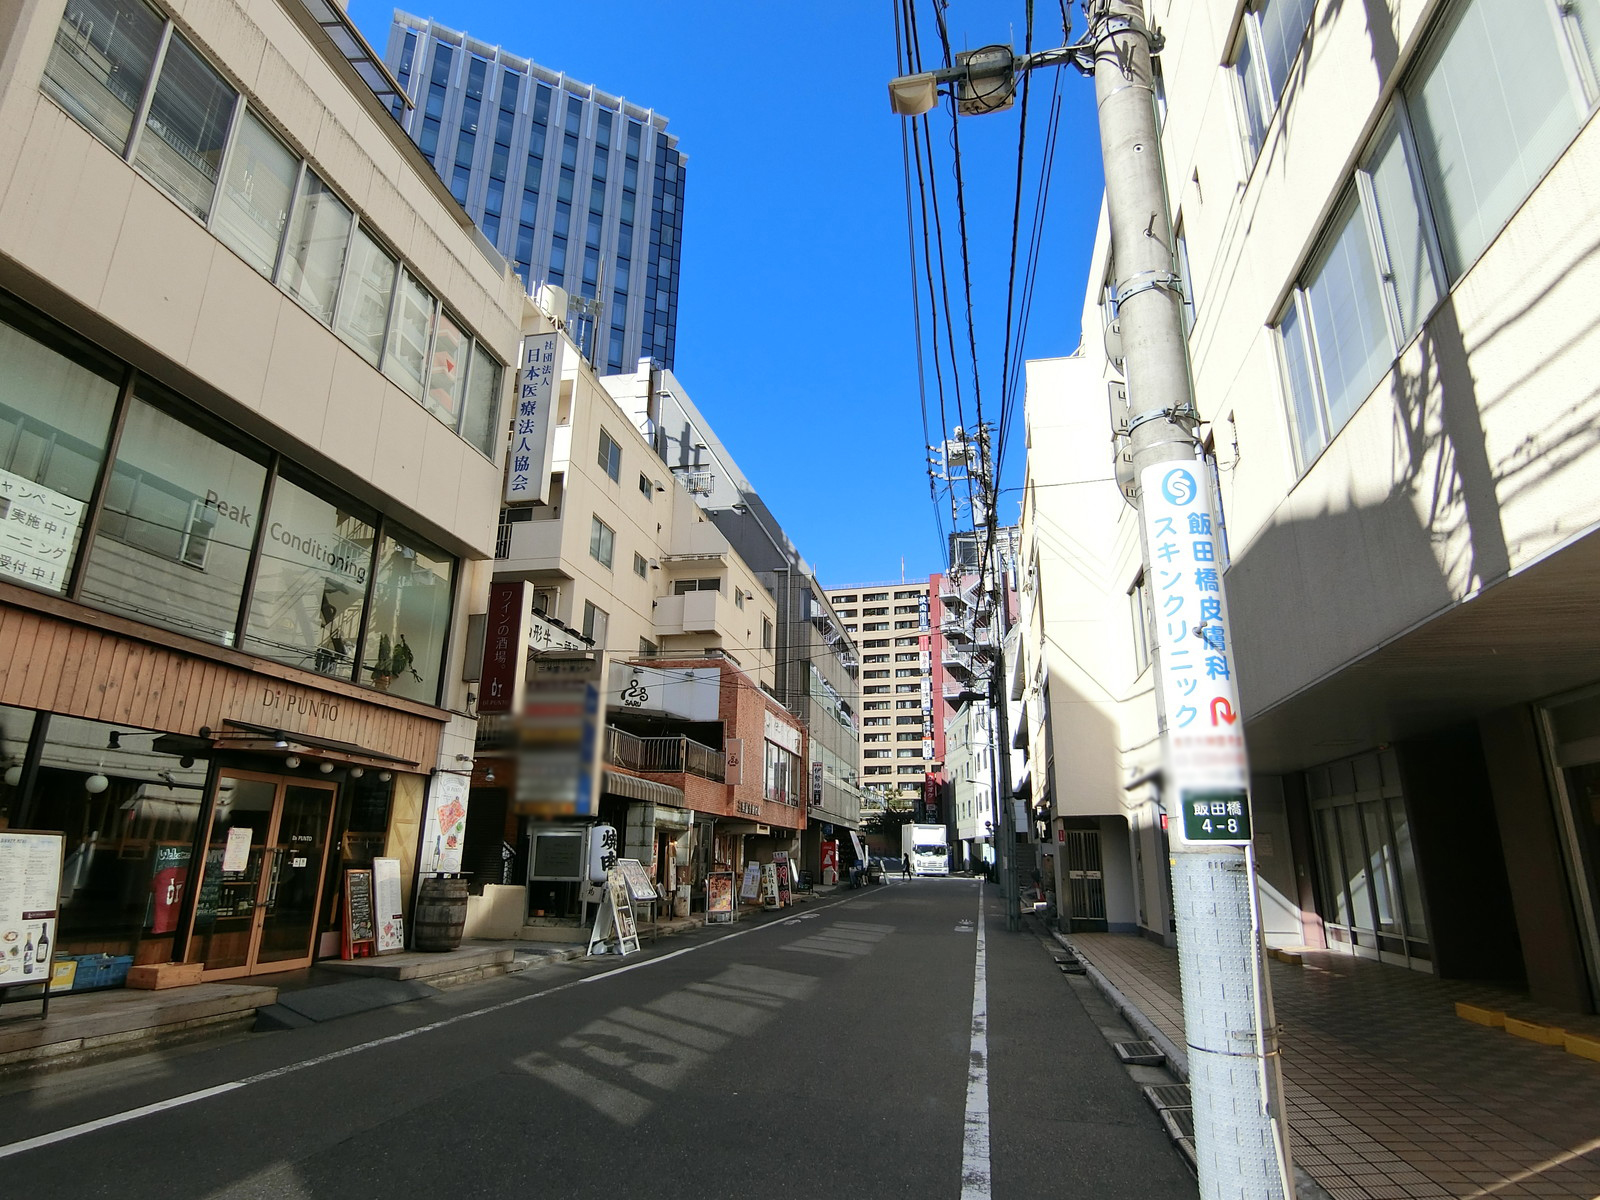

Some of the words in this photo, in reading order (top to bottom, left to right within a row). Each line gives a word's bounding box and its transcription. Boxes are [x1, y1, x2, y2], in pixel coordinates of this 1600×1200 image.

[541, 340, 554, 386] 社団法人
[512, 348, 541, 491] 日本医療法人協会
[10, 508, 68, 539] 実施中！
[204, 489, 252, 528] Peak
[270, 522, 366, 584] Conditioning
[1187, 512, 1231, 681] 飯田橋皮膚科
[1154, 517, 1197, 728] スキンクリニック
[263, 688, 280, 708] Di
[286, 694, 339, 722] PUNTO
[624, 699, 642, 708] SARU
[1193, 801, 1242, 816] 飯田橋
[1201, 818, 1238, 834] 4-8
[600, 829, 617, 871] 焼肉
